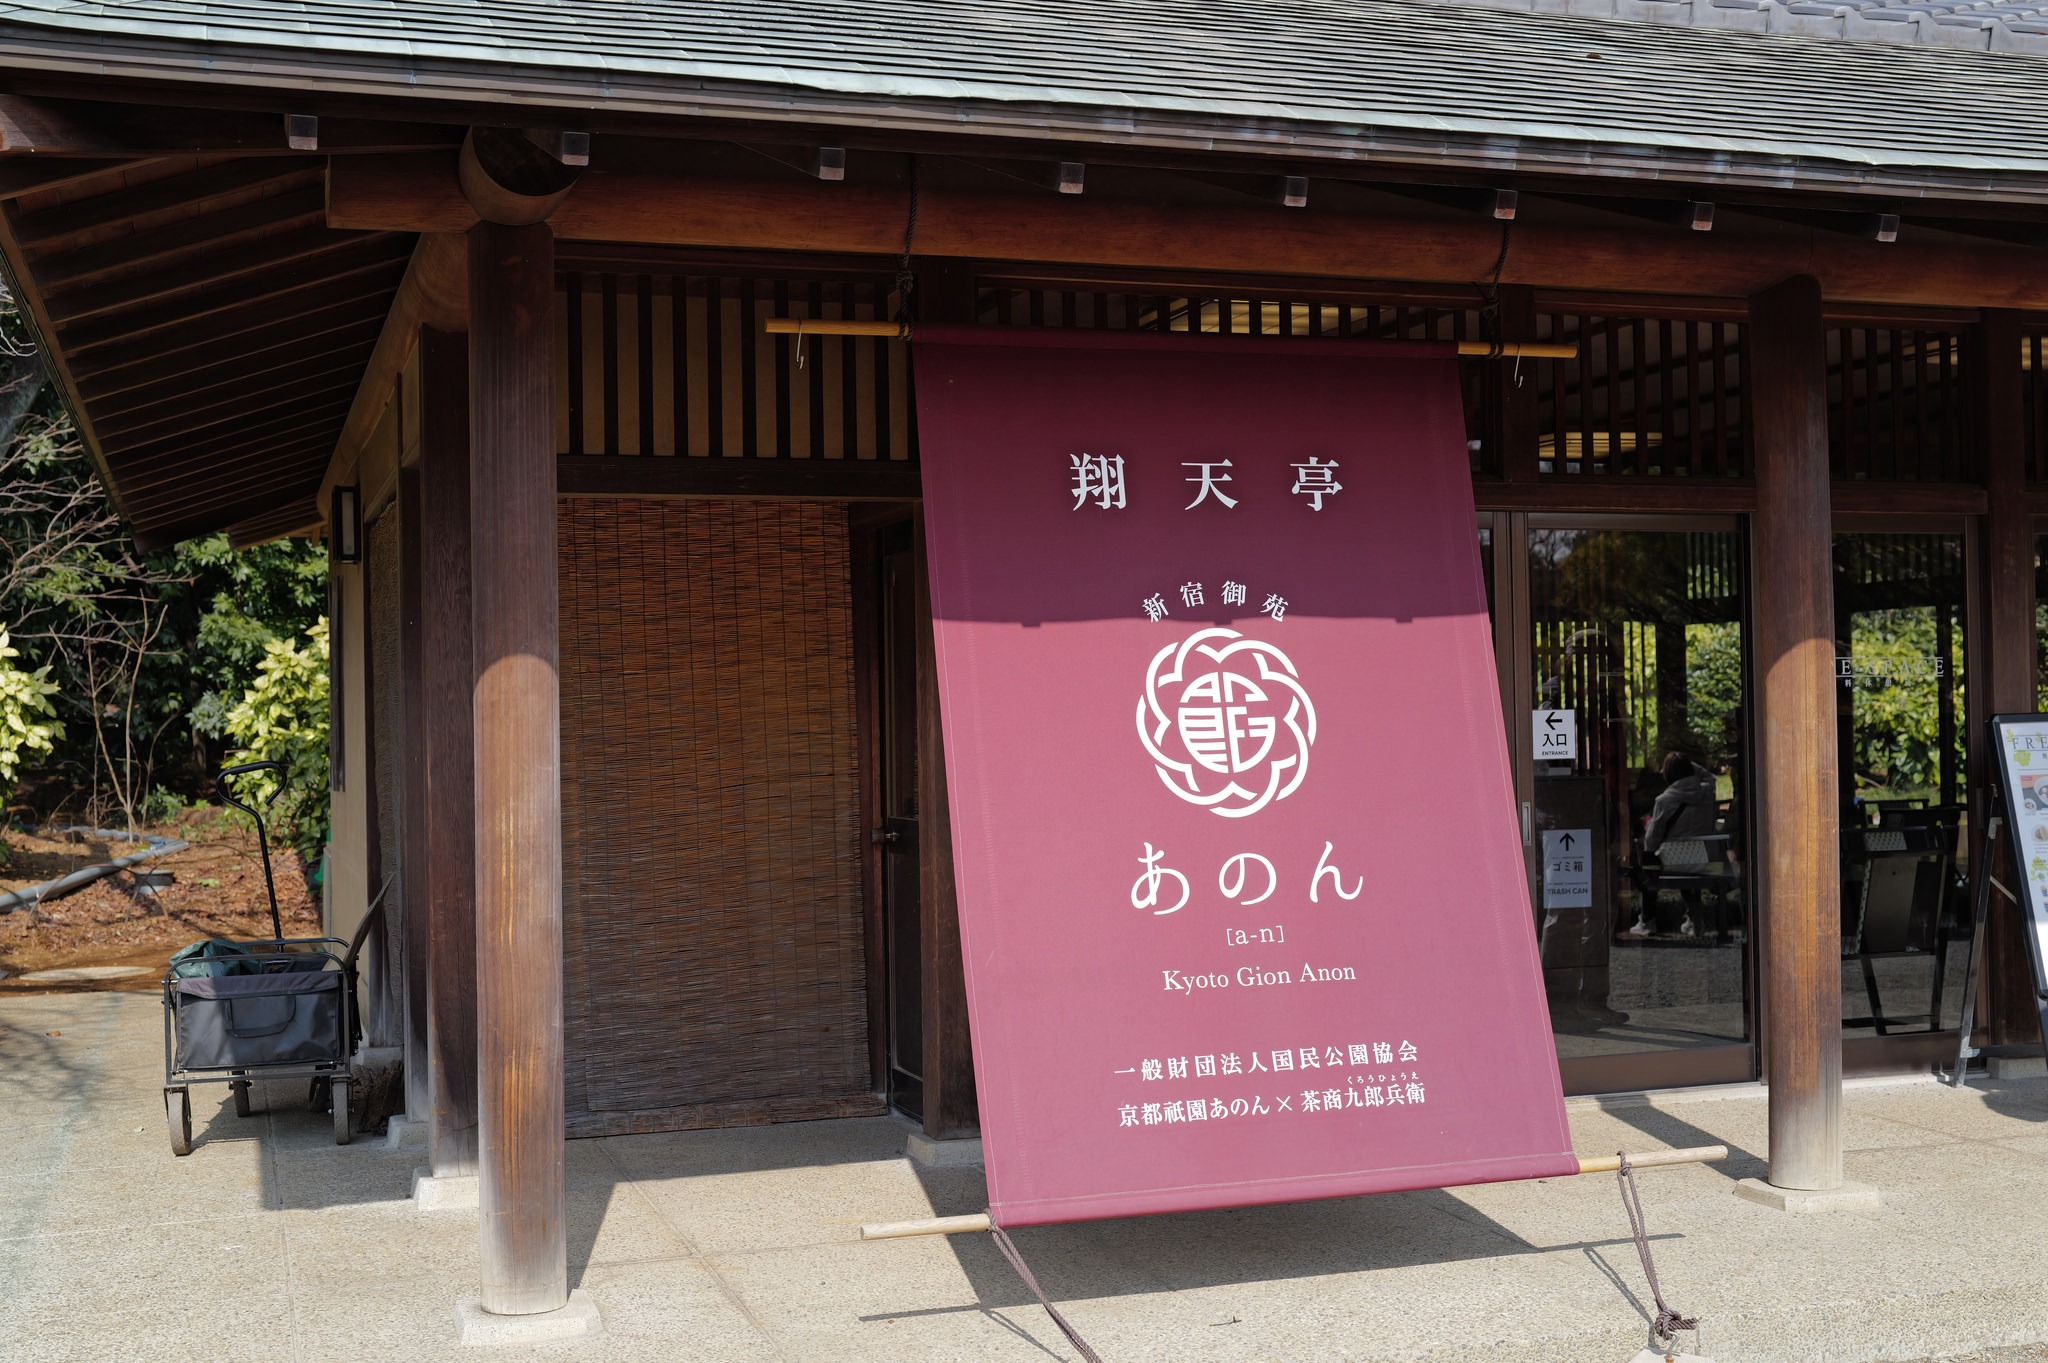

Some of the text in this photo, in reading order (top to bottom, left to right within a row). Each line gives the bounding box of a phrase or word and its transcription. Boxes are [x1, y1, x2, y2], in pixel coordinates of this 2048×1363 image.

[1069, 452, 1343, 512] 翔天亭
[1141, 580, 1289, 623] 新宿御苑
[1868, 659, 1945, 675] SPACE
[1542, 733, 1567, 747] 入口
[1130, 840, 1364, 916] あのん
[1552, 860, 1583, 873] ゴミ箱
[1547, 887, 1589, 896] TRASH CAN
[1226, 925, 1285, 946] [a-n]
[1162, 962, 1357, 996] Kyoto Gion Anon
[1113, 1039, 1418, 1082] 一般財団法人国民公園協会
